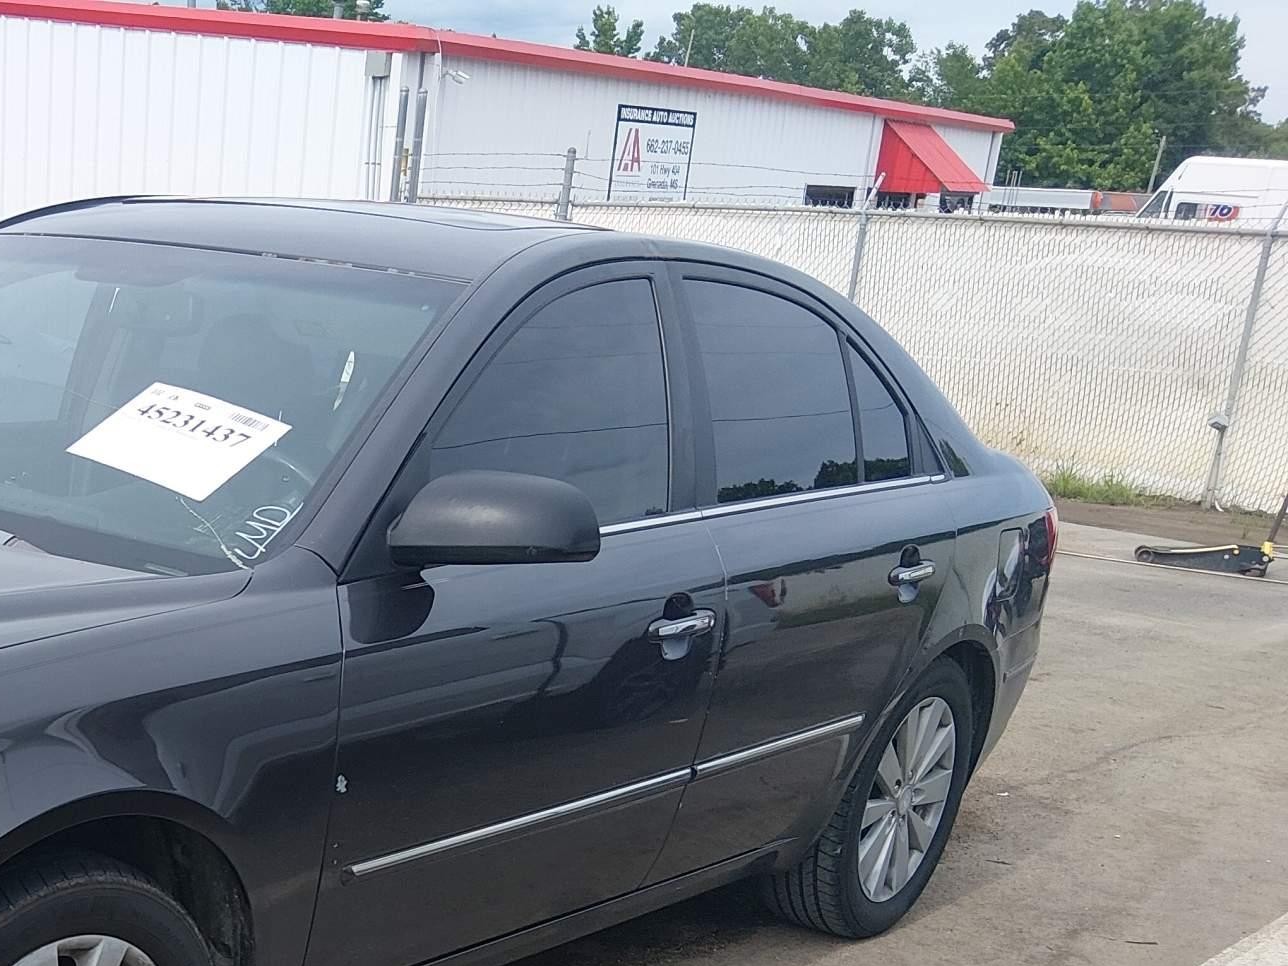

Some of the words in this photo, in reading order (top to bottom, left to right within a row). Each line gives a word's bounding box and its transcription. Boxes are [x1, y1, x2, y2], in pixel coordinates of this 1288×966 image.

[621, 107, 652, 121] INSURANCE
[652, 110, 668, 123] AUTO
[668, 112, 694, 126] AUCTIONS
[1207, 204, 1233, 218] 76
[137, 403, 252, 447] 45231437
